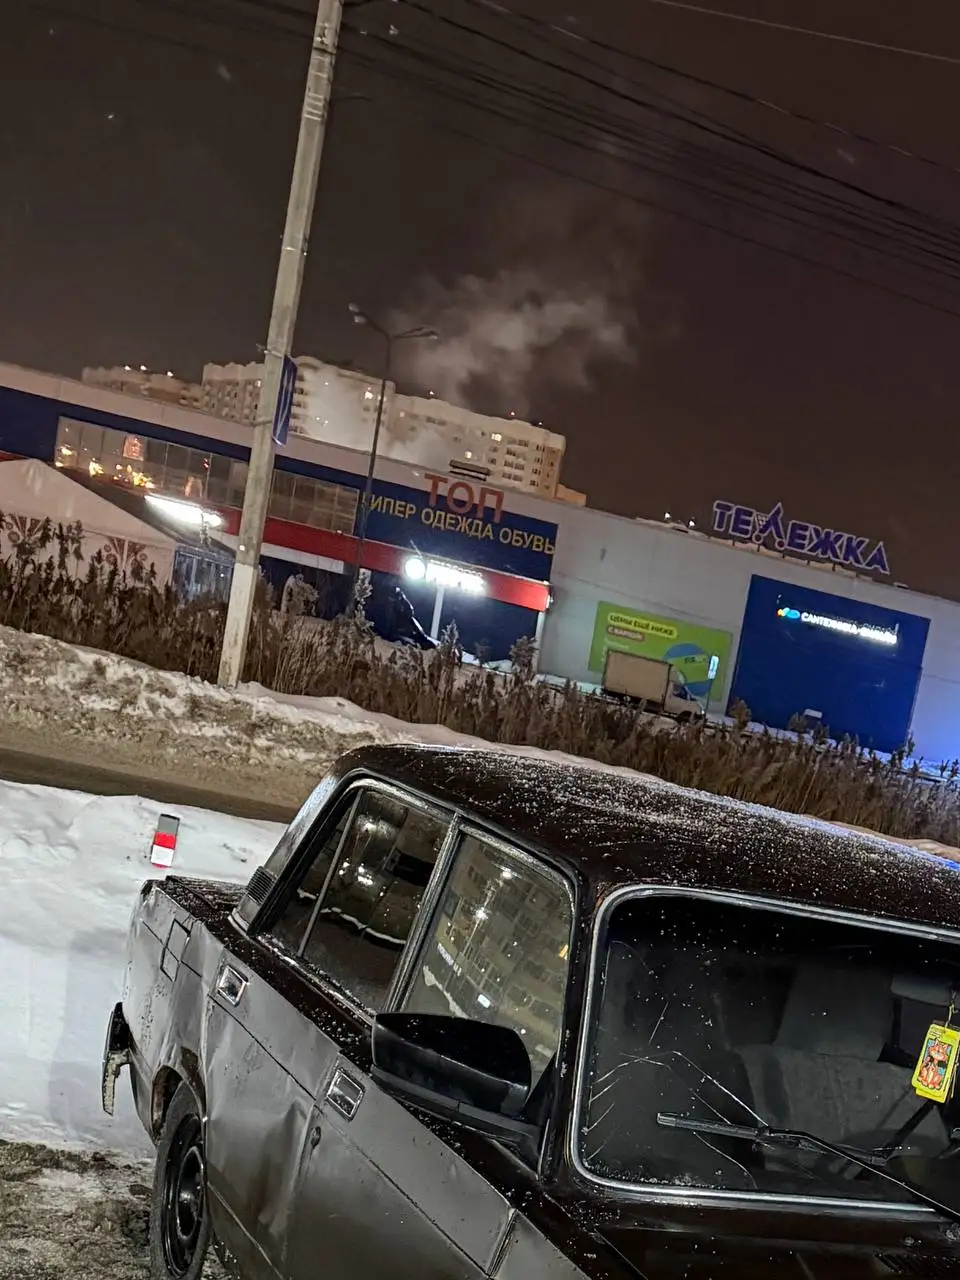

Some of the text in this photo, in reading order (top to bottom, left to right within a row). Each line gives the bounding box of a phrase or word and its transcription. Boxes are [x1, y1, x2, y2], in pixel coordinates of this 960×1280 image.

[424, 472, 504, 523] ТОП
[421, 508, 493, 539] ОДЕЖДА
[499, 527, 556, 555] ОБУВЬ
[713, 500, 890, 575] ТЕЛЕЖКА
